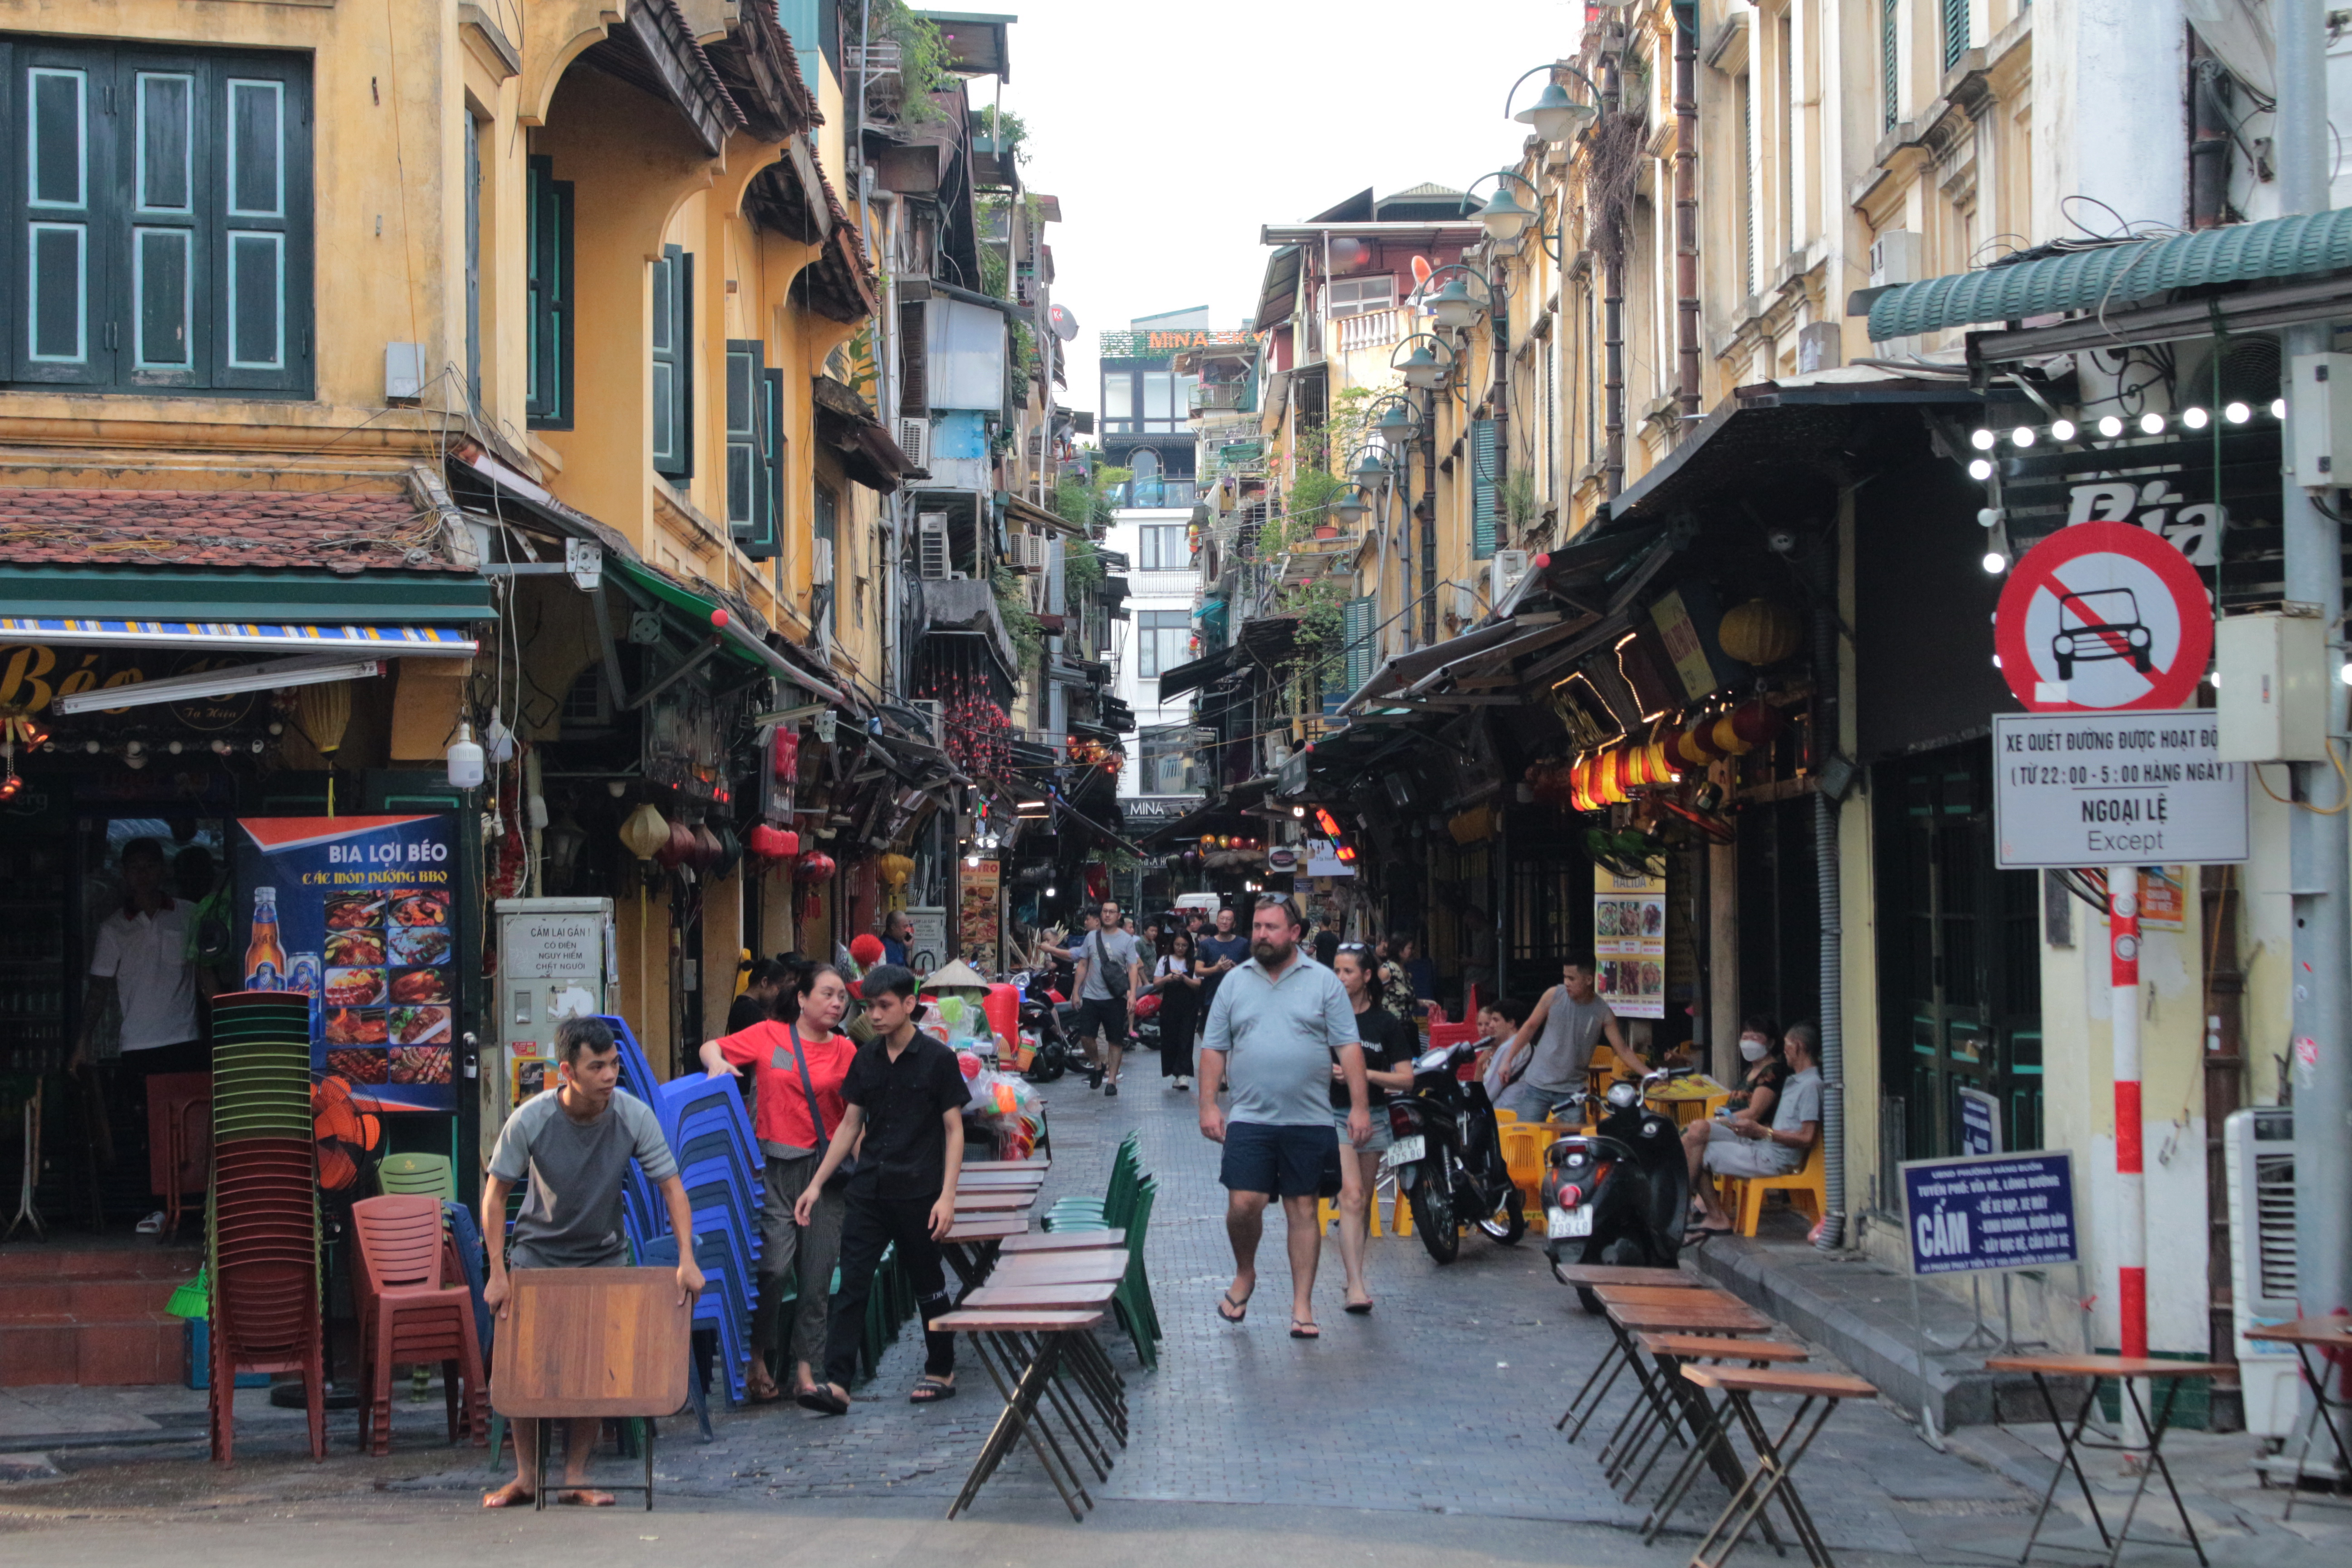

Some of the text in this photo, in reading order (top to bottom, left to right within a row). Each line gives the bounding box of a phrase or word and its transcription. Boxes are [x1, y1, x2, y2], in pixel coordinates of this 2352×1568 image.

[1150, 331, 1209, 348] MINA
[2006, 734, 2023, 752] XE
[2028, 728, 2062, 751] QUÉT
[2067, 727, 2114, 750] ĐƯỜNG
[2118, 729, 2156, 753] ĐƯỢC
[2161, 729, 2196, 752] HOẠT
[2144, 759, 2181, 782] HÀNG
[1130, 802, 1165, 815] MINA
[2082, 793, 2168, 826] NGOẠI LỆ
[2088, 830, 2164, 856] Except
[329, 838, 448, 867] BIA LỢI BÉO
[418, 870, 448, 884] BBQ
[531, 925, 549, 937] CẤM
[552, 928, 565, 939] LẠI
[544, 941, 577, 951] CÓ ĐIỆN
[564, 949, 583, 959] HIỂM
[536, 961, 585, 970] CHẾT NGƯỜI
[1917, 1197, 1970, 1258] CẤM
